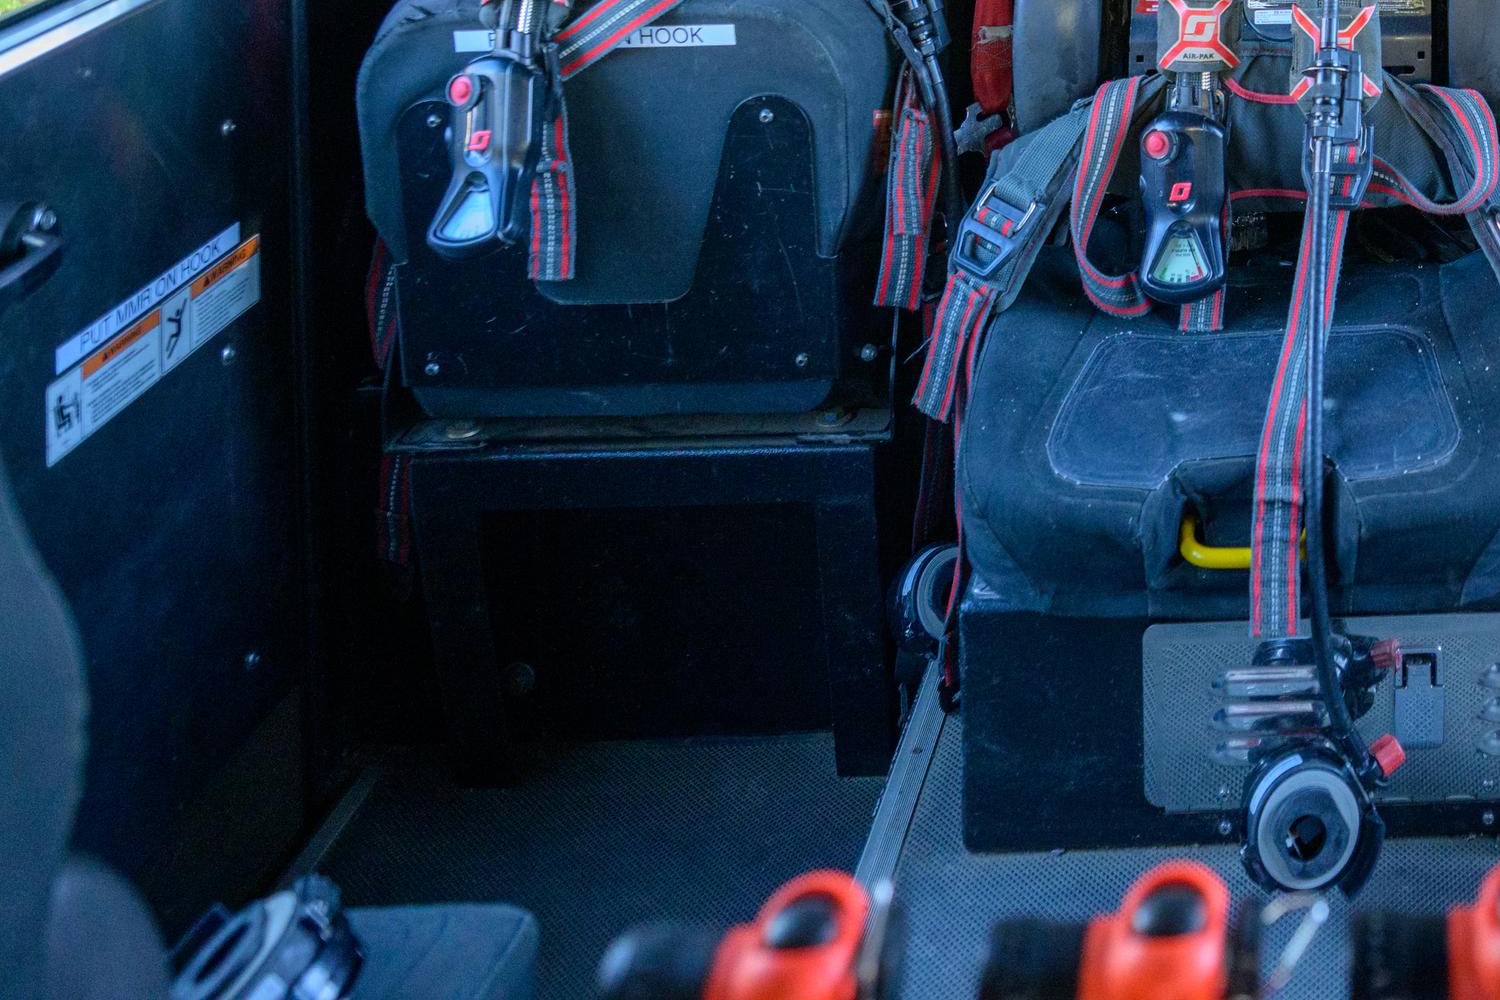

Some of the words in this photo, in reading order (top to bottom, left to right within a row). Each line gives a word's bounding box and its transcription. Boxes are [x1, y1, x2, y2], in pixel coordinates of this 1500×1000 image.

[639, 28, 704, 45] HOOK
[1182, 52, 1215, 60] AIR-PAK
[80, 315, 110, 353] PUT
[155, 270, 176, 298] ON
[181, 241, 221, 276] HOOK
